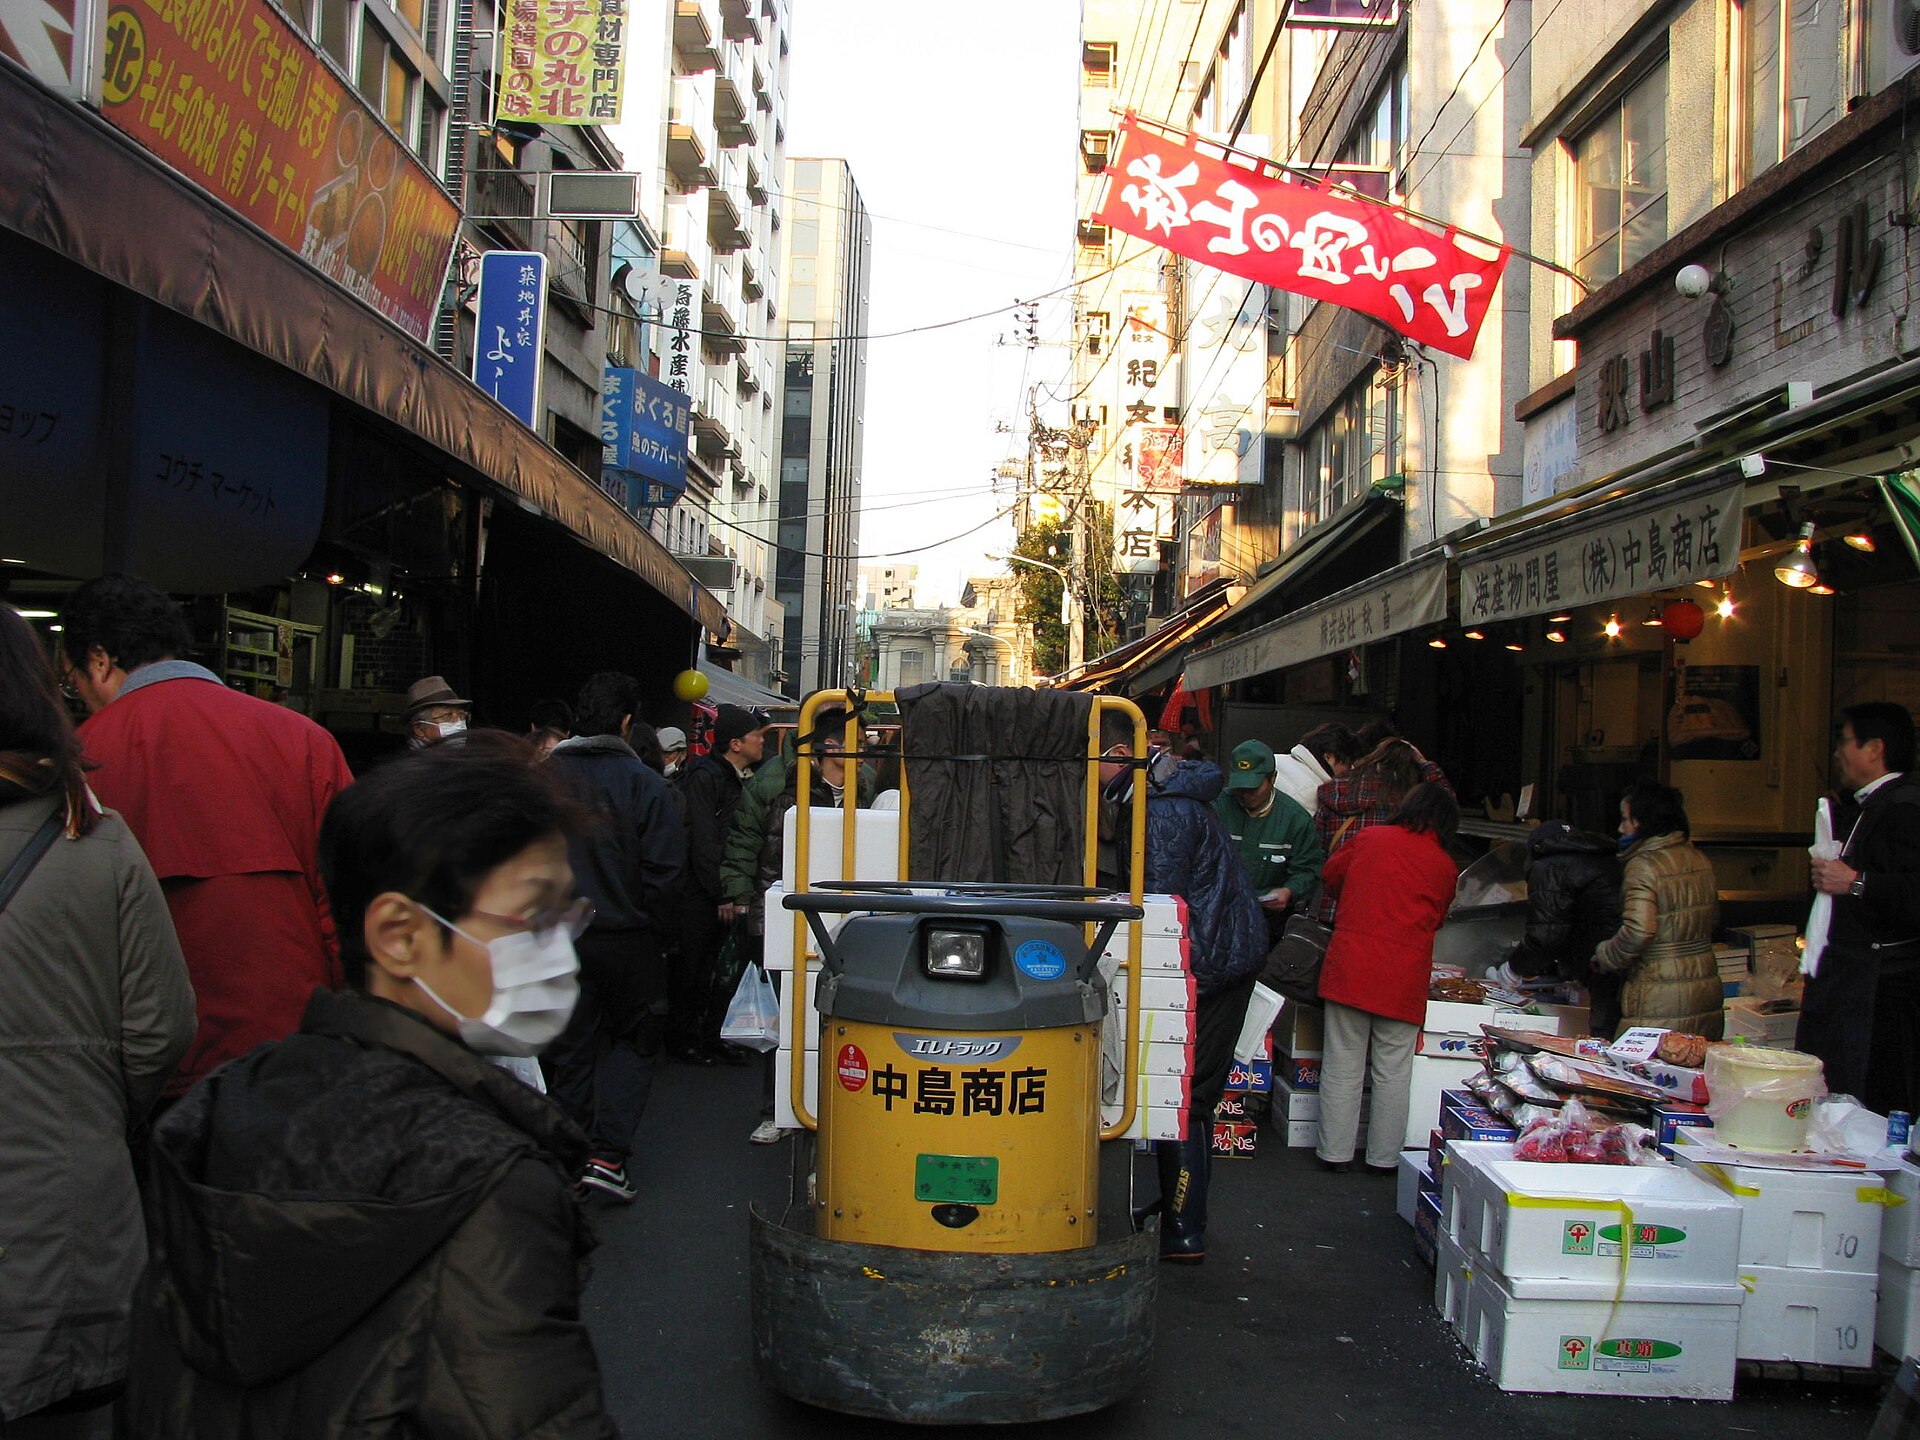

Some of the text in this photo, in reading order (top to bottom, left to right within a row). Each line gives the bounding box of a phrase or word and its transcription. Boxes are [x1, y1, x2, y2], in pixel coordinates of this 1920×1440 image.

[634, 386, 688, 434] まぐろ屋
[632, 430, 686, 470] 魚のデパート
[1472, 550, 1561, 617] 海産物問屋
[911, 1039, 1002, 1057] エレトラック
[872, 1063, 1048, 1117] 中島商店
[1172, 1169, 1190, 1214] ZACTAS
[1834, 1232, 1859, 1259] 10
[1834, 1325, 1859, 1350] 10
